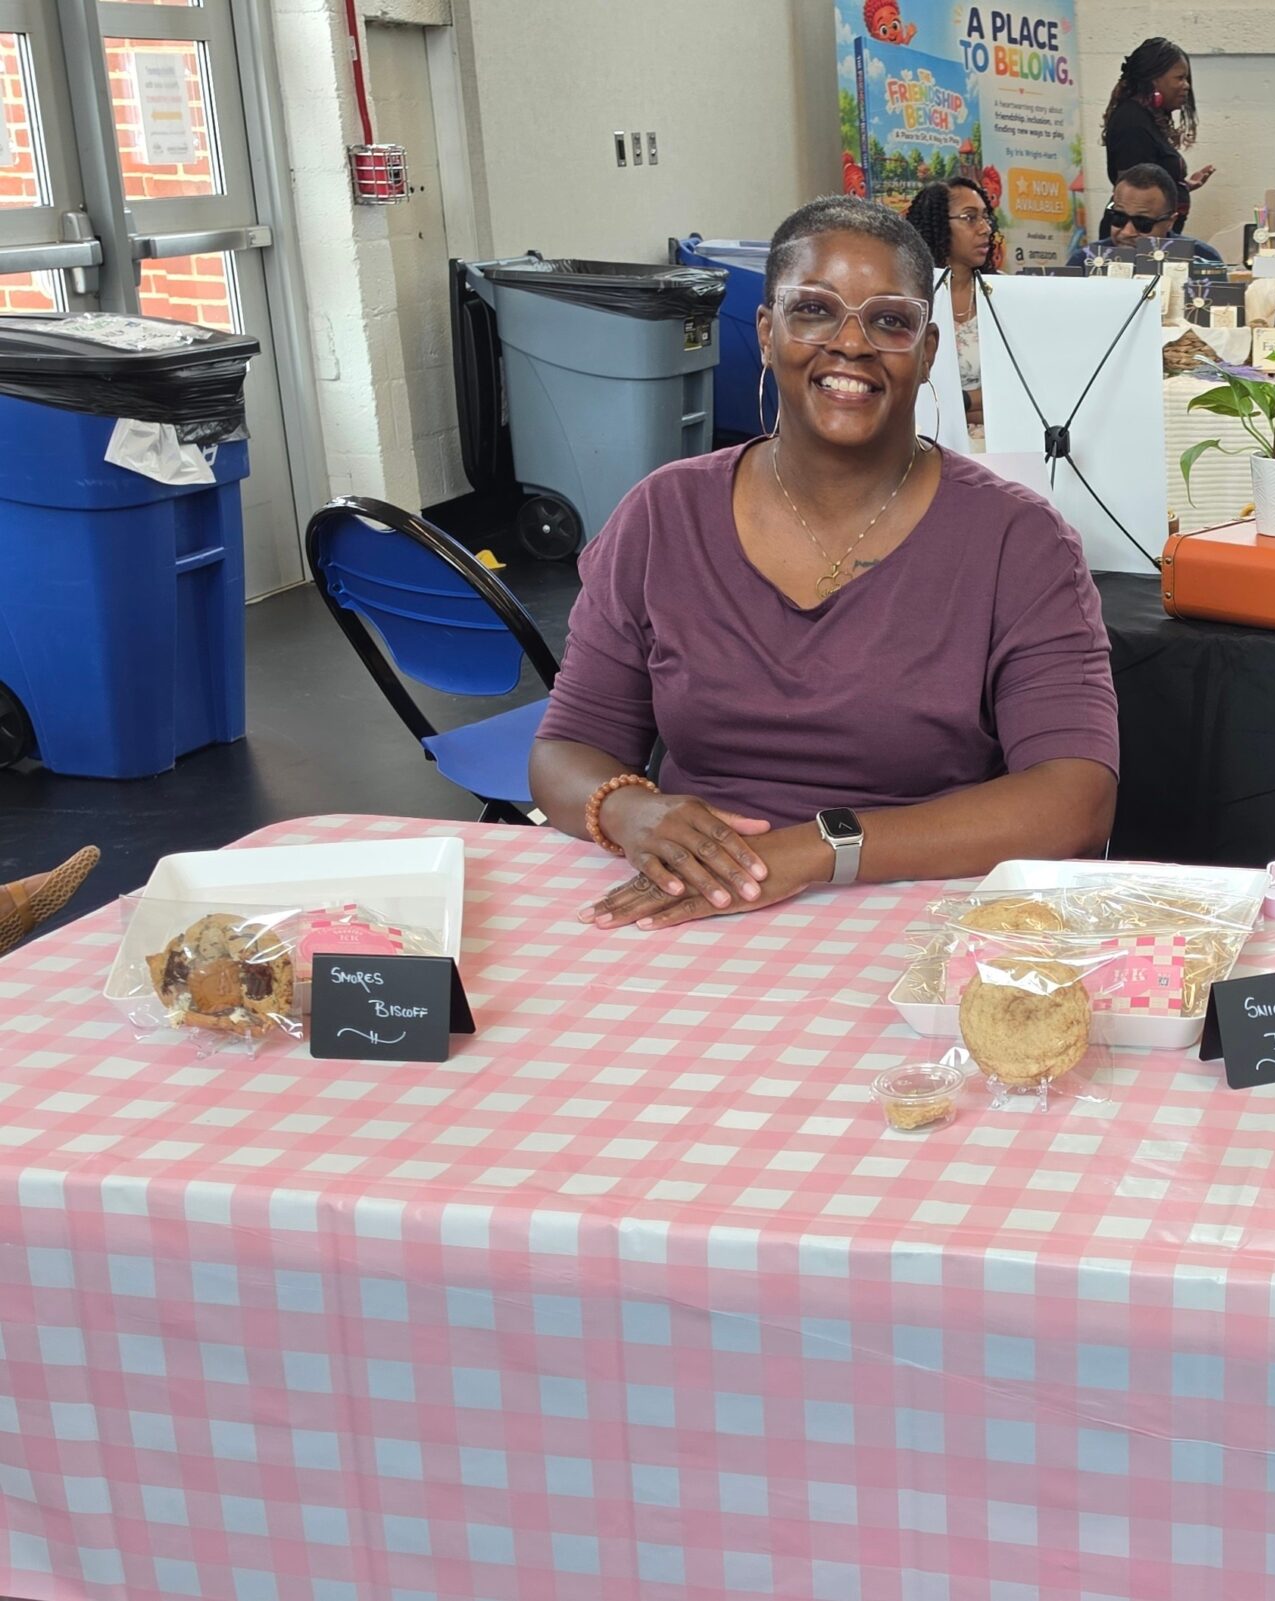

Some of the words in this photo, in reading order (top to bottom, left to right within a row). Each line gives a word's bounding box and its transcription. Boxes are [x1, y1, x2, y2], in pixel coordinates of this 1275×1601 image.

[967, 7, 985, 39] A
[992, 10, 1059, 51] PLACE
[960, 40, 989, 73] TO
[994, 45, 1073, 86] BELONG.
[886, 79, 963, 113] FRIENDSHIP
[999, 101, 1034, 113] heartwarming
[1035, 106, 1047, 114] story
[1049, 106, 1063, 114] about
[903, 103, 949, 130] BENCH
[1027, 115, 1052, 125] inclusion,
[994, 124, 1016, 136] finding
[1030, 130, 1043, 138] ways
[1006, 147, 1014, 157] By
[1015, 148, 1023, 157] Iris
[1032, 180, 1060, 197] NOW
[1016, 199, 1064, 212] AVAILABLE!
[1015, 247, 1024, 261] a
[1028, 250, 1058, 260] amazon
[330, 966, 384, 994] SMORES
[368, 999, 429, 1018] BISCOFF
